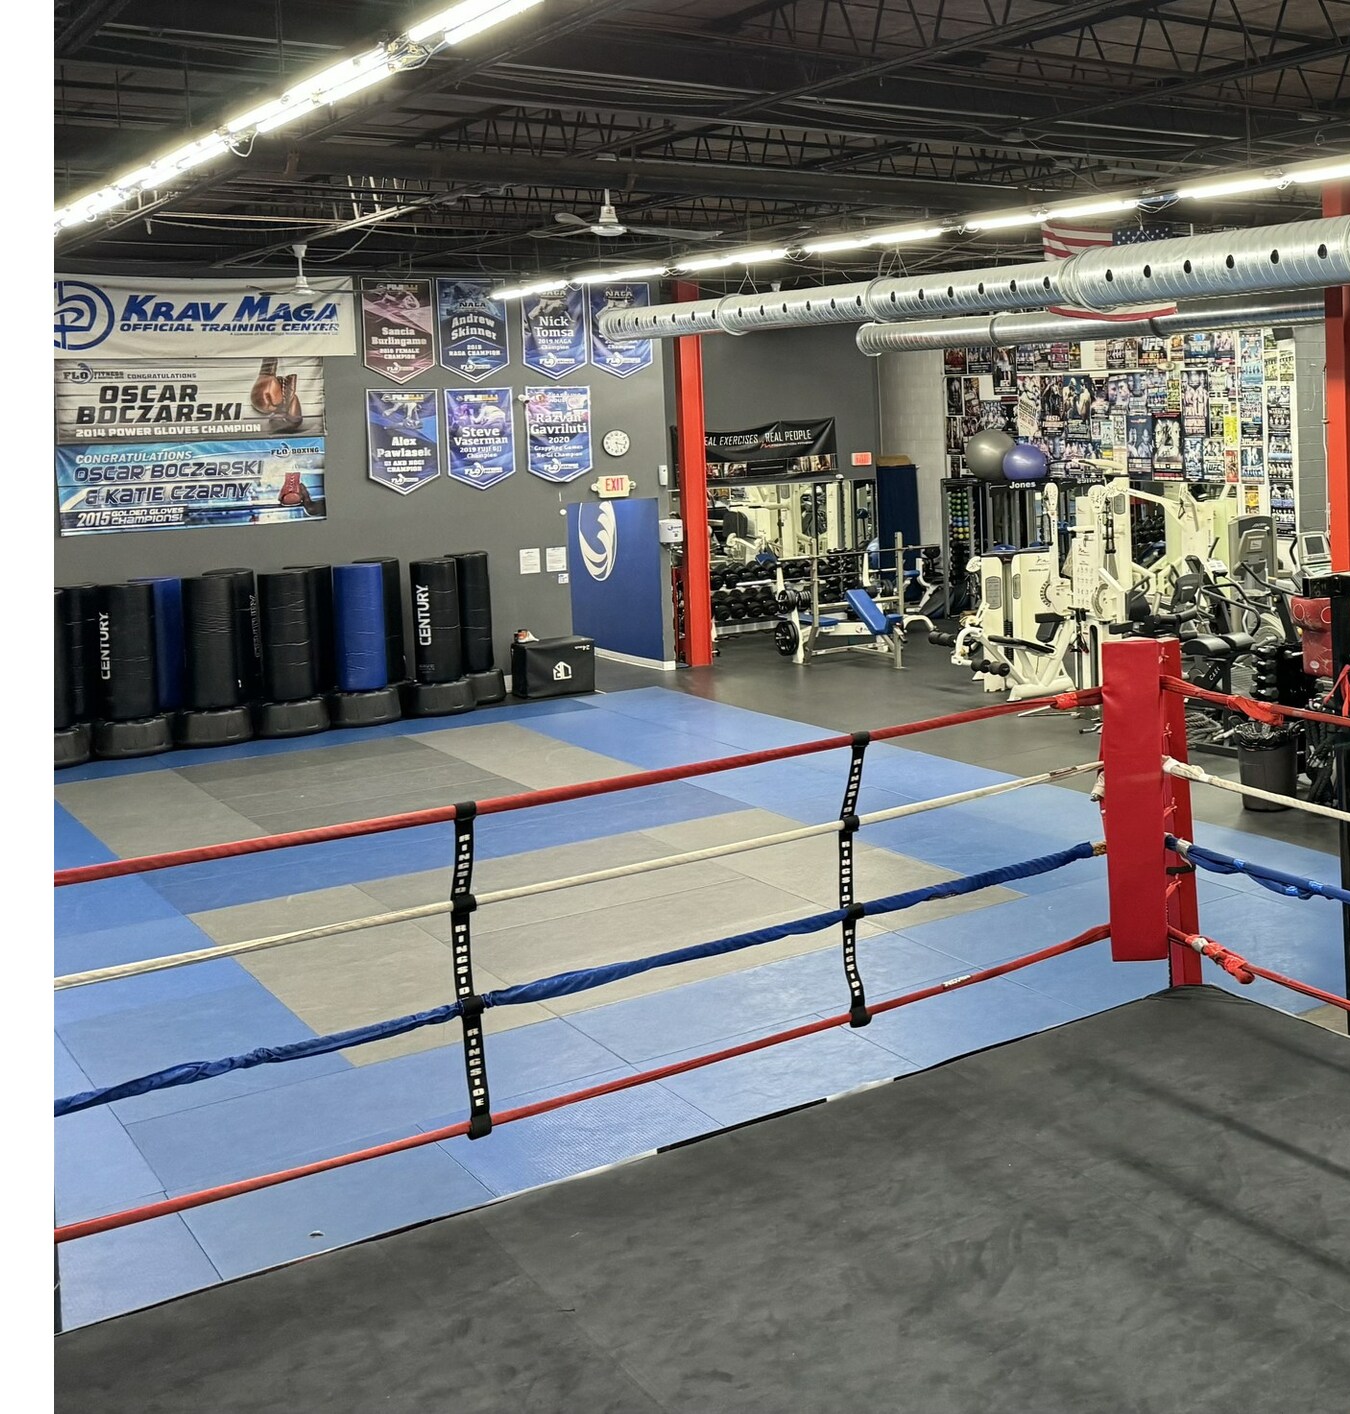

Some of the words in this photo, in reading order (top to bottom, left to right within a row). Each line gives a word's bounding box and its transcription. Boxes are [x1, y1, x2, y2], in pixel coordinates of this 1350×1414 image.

[120, 294, 228, 322] KRAV
[232, 295, 339, 322] MAGA
[120, 323, 194, 332] OFFICIAL
[201, 323, 276, 332] TRAINING
[281, 323, 339, 332] CENTER
[451, 313, 495, 329] Andrew
[539, 315, 569, 327] Nick
[381, 327, 416, 336] Sancia
[451, 325, 497, 341] Skinner
[533, 326, 575, 337] Tomsa
[63, 371, 90, 381] FLO
[98, 384, 198, 404] OSCAR
[76, 402, 242, 425] BOCZARSKI
[537, 413, 582, 423] Razvan
[75, 428, 106, 438] 2014
[108, 427, 152, 437] POWER
[154, 426, 199, 435] GLOVES
[201, 424, 261, 434] CHAMPION
[462, 426, 501, 437] Steve
[530, 422, 588, 435] Gavriluti
[391, 436, 417, 446] Alex
[453, 436, 509, 446] Vaserman
[548, 436, 570, 444] 2020
[704, 436, 717, 447] EAL
[765, 431, 783, 443] REAL
[785, 429, 812, 441] PEOPLE
[75, 450, 193, 465] CONGRATULATIONS
[291, 447, 320, 455] BOXING
[605, 477, 625, 492] EXIT
[1009, 481, 1036, 489] Jones
[76, 511, 111, 528] 2015
[149, 506, 185, 515] GLOVES
[416, 584, 431, 647] CENTURY
[99, 611, 111, 681] CENTURY
[844, 758, 862, 818] RINGSID
[455, 833, 471, 894] RINGSID
[455, 924, 471, 996] RINGSID
[845, 928, 861, 997] RINGSIDE
[467, 1027, 485, 1107] RINGSIDE
